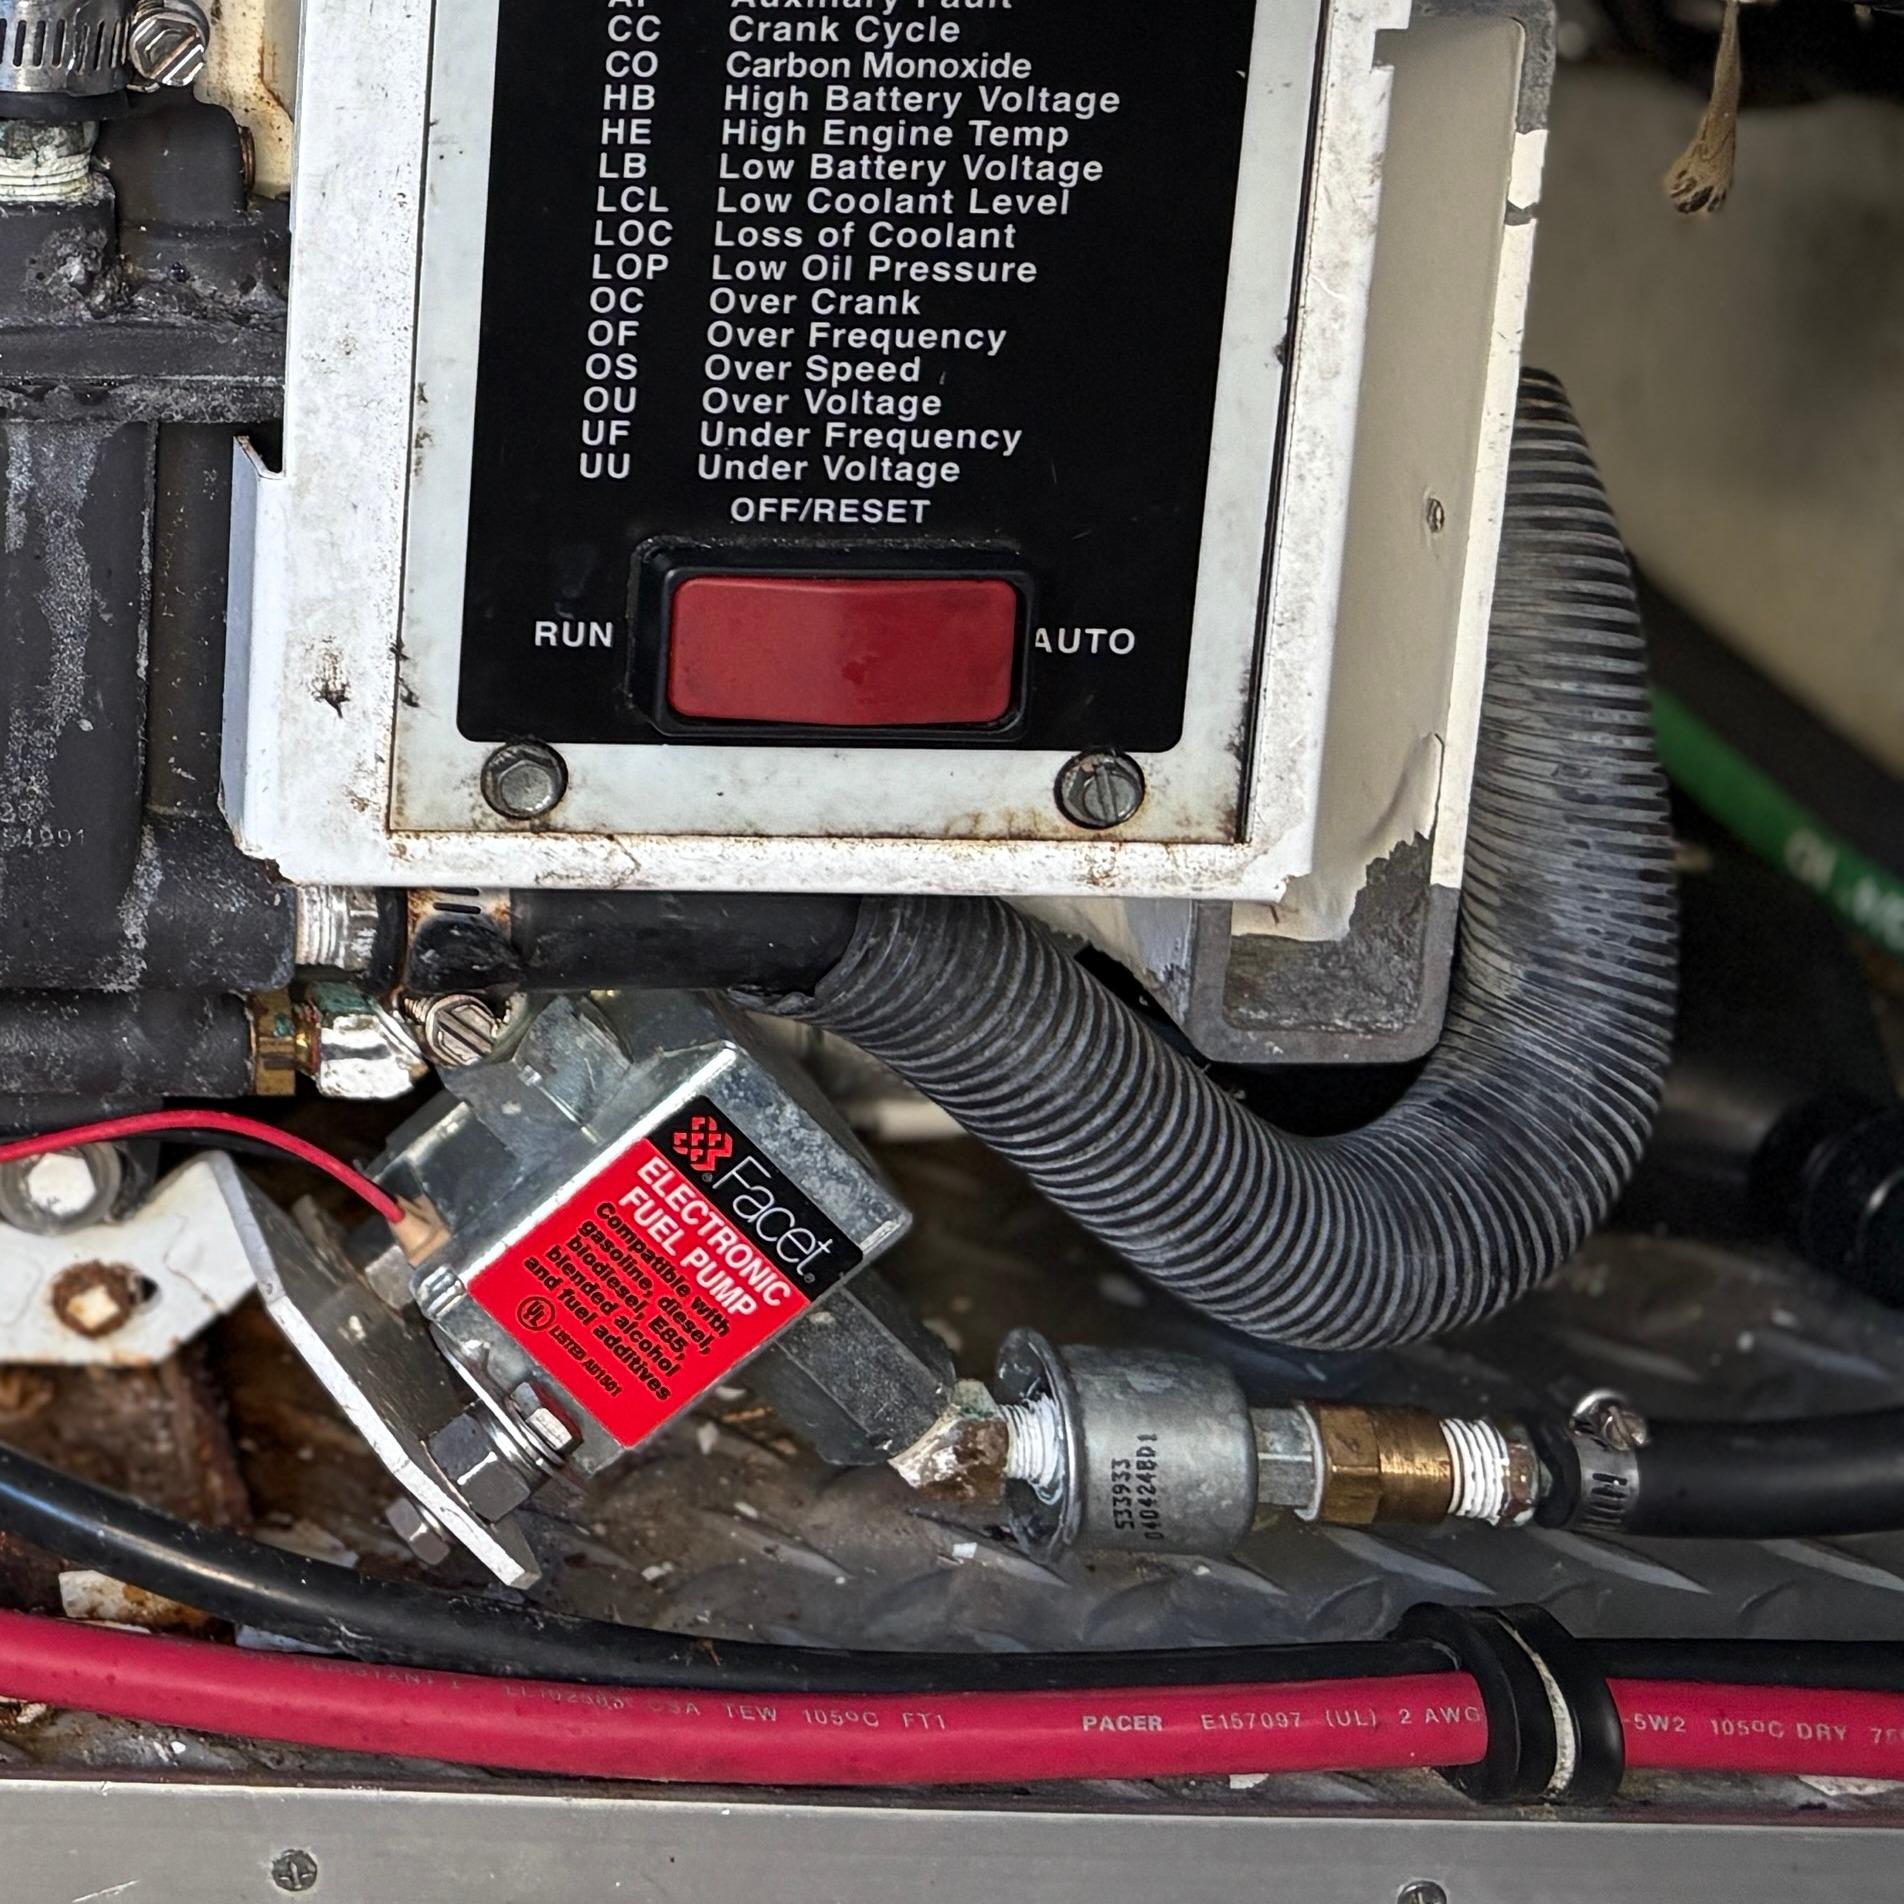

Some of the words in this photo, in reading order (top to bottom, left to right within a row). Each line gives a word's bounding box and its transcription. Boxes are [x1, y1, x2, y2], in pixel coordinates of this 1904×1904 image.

[606, 14, 661, 42] CC
[728, 14, 841, 43] Crank
[856, 14, 962, 49] Cycle
[605, 51, 659, 79] CO
[726, 51, 852, 79] Carbon
[863, 51, 1034, 79] Monoxide
[602, 85, 655, 112] HB
[723, 85, 809, 120] High
[824, 85, 963, 121] Battery
[979, 85, 1121, 120] Voltage
[600, 118, 652, 146] HE
[721, 118, 807, 154] High
[823, 120, 954, 154] Engine
[968, 120, 1070, 153] Temp
[598, 153, 647, 180] LB
[719, 154, 794, 181] Low
[810, 153, 948, 188] Battery
[962, 153, 1104, 188] Voltage
[596, 187, 669, 214] LCL
[716, 187, 793, 215] Low
[807, 187, 954, 215] Coolant
[970, 188, 1070, 215] Level
[594, 220, 673, 248] LOC
[714, 221, 802, 249] Loss
[817, 221, 855, 248] of
[868, 221, 1017, 248] Coolant
[592, 254, 670, 281] LOP
[712, 254, 788, 281] Low
[802, 253, 853, 281] Oil
[867, 255, 1038, 284] Pressure
[590, 287, 644, 315] OC
[709, 288, 796, 316] Over
[810, 288, 921, 316] Crank
[588, 321, 639, 347] OF
[706, 321, 794, 349] Over
[809, 321, 1007, 356] Frequency
[585, 354, 638, 381] OS
[704, 355, 791, 383] Over
[805, 355, 921, 390] Speed
[584, 387, 637, 414] OU
[701, 388, 789, 416] Over
[804, 388, 942, 424] Voltage
[581, 420, 631, 447] UF
[699, 421, 811, 449] Under
[824, 421, 1023, 457] Frequency
[579, 453, 630, 481] UU
[698, 454, 809, 483] Under
[823, 454, 961, 490] Voltage
[730, 496, 930, 524] OFF/RESET
[534, 621, 614, 648] RUN
[1032, 626, 1137, 656] AUTO
[637, 1156, 793, 1307] ELECTRONIC
[713, 1155, 833, 1276] Facet
[619, 1185, 685, 1256] FUEL
[680, 1247, 759, 1318] PUMP
[595, 1202, 691, 1300] Compatible
[692, 1297, 730, 1337] with
[546, 1245, 616, 1316] blended
[614, 1315, 681, 1377] alcohol
[1112, 1457, 1134, 1530] 533933
[1082, 1714, 1164, 1733] PACER
[1201, 1712, 1303, 1732] E157097
